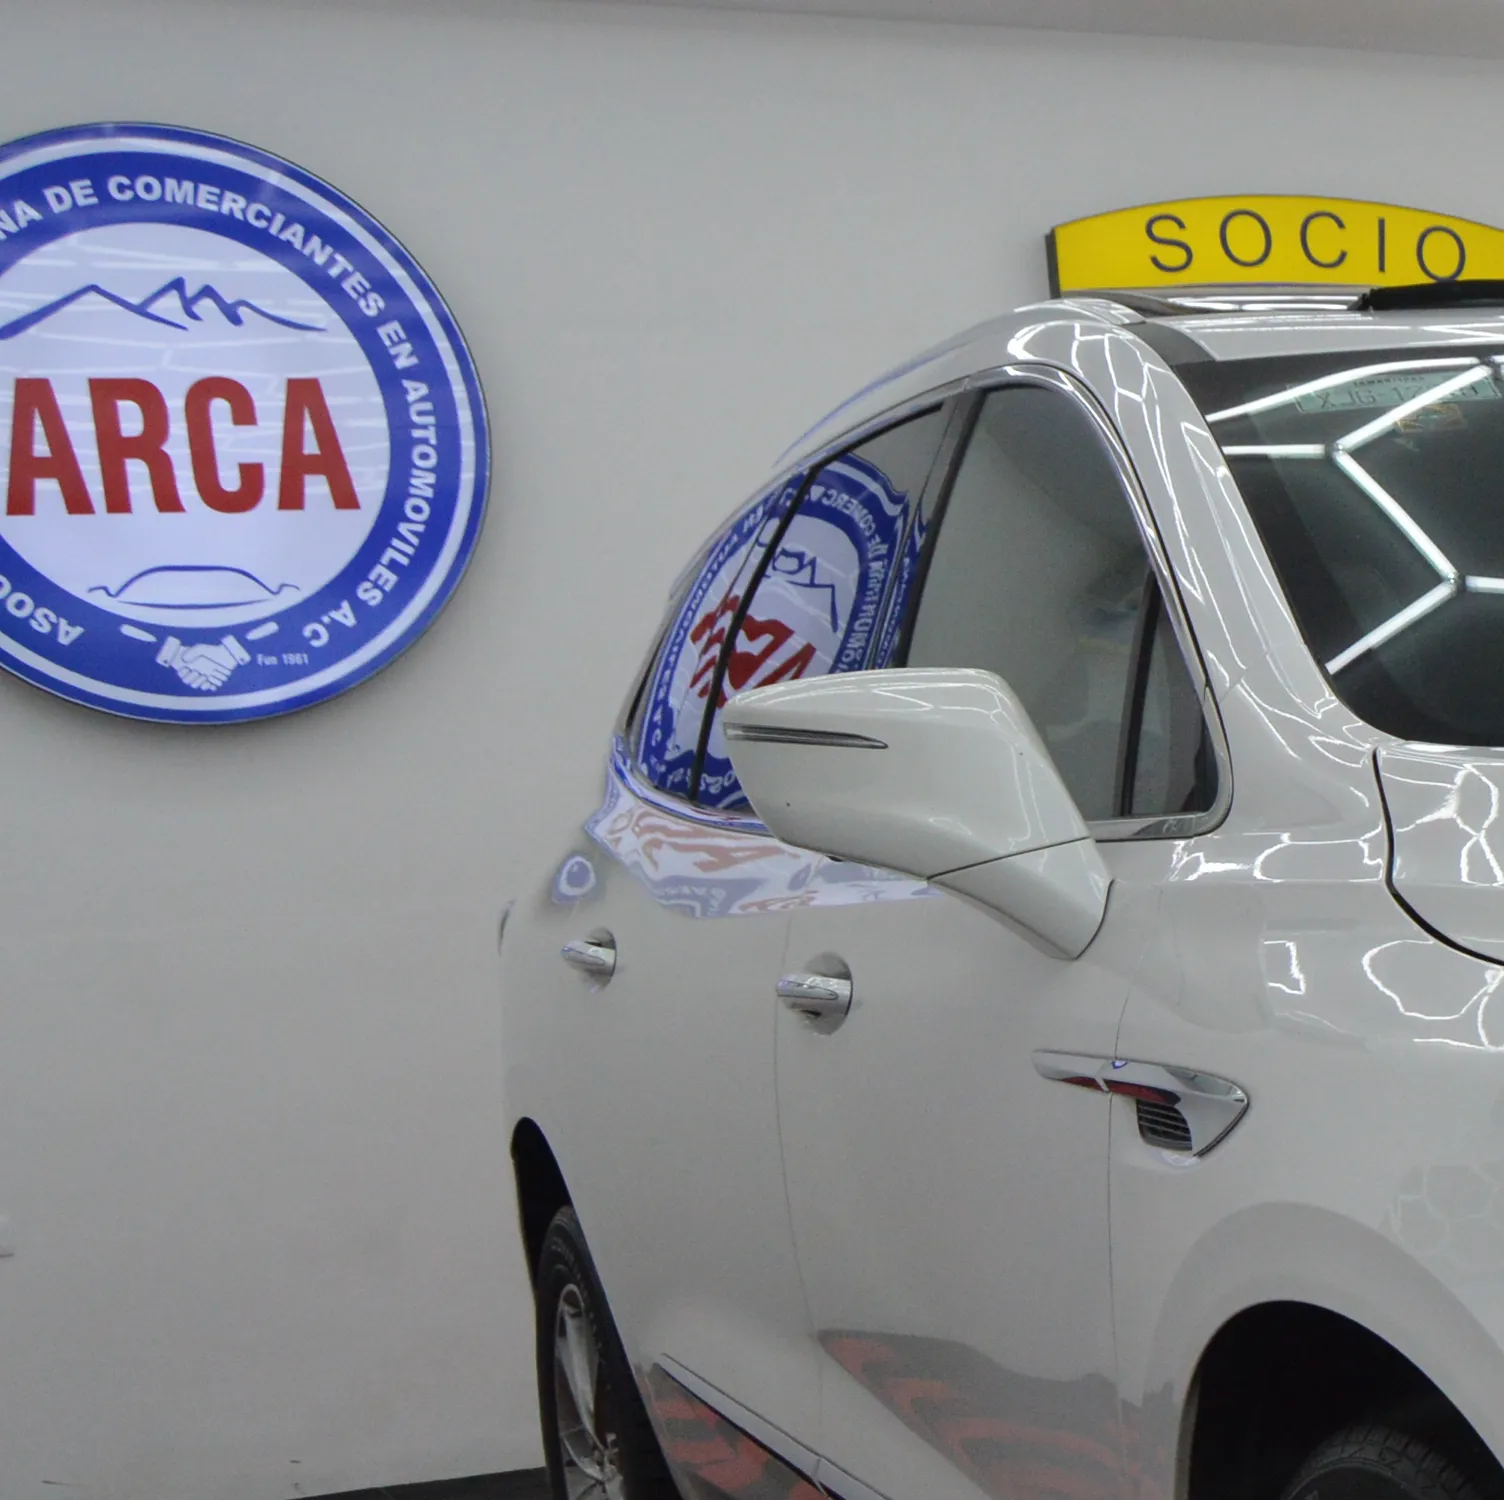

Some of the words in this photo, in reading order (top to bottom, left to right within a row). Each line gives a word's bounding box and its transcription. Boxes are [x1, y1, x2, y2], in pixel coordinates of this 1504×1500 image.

[42, 179, 99, 214] DE
[107, 174, 385, 317] COMERCIANTES
[1144, 207, 1466, 282] SOCIO
[376, 320, 420, 371] EN
[5, 375, 361, 516] ARCA
[356, 377, 439, 607] AUTOMOVILES
